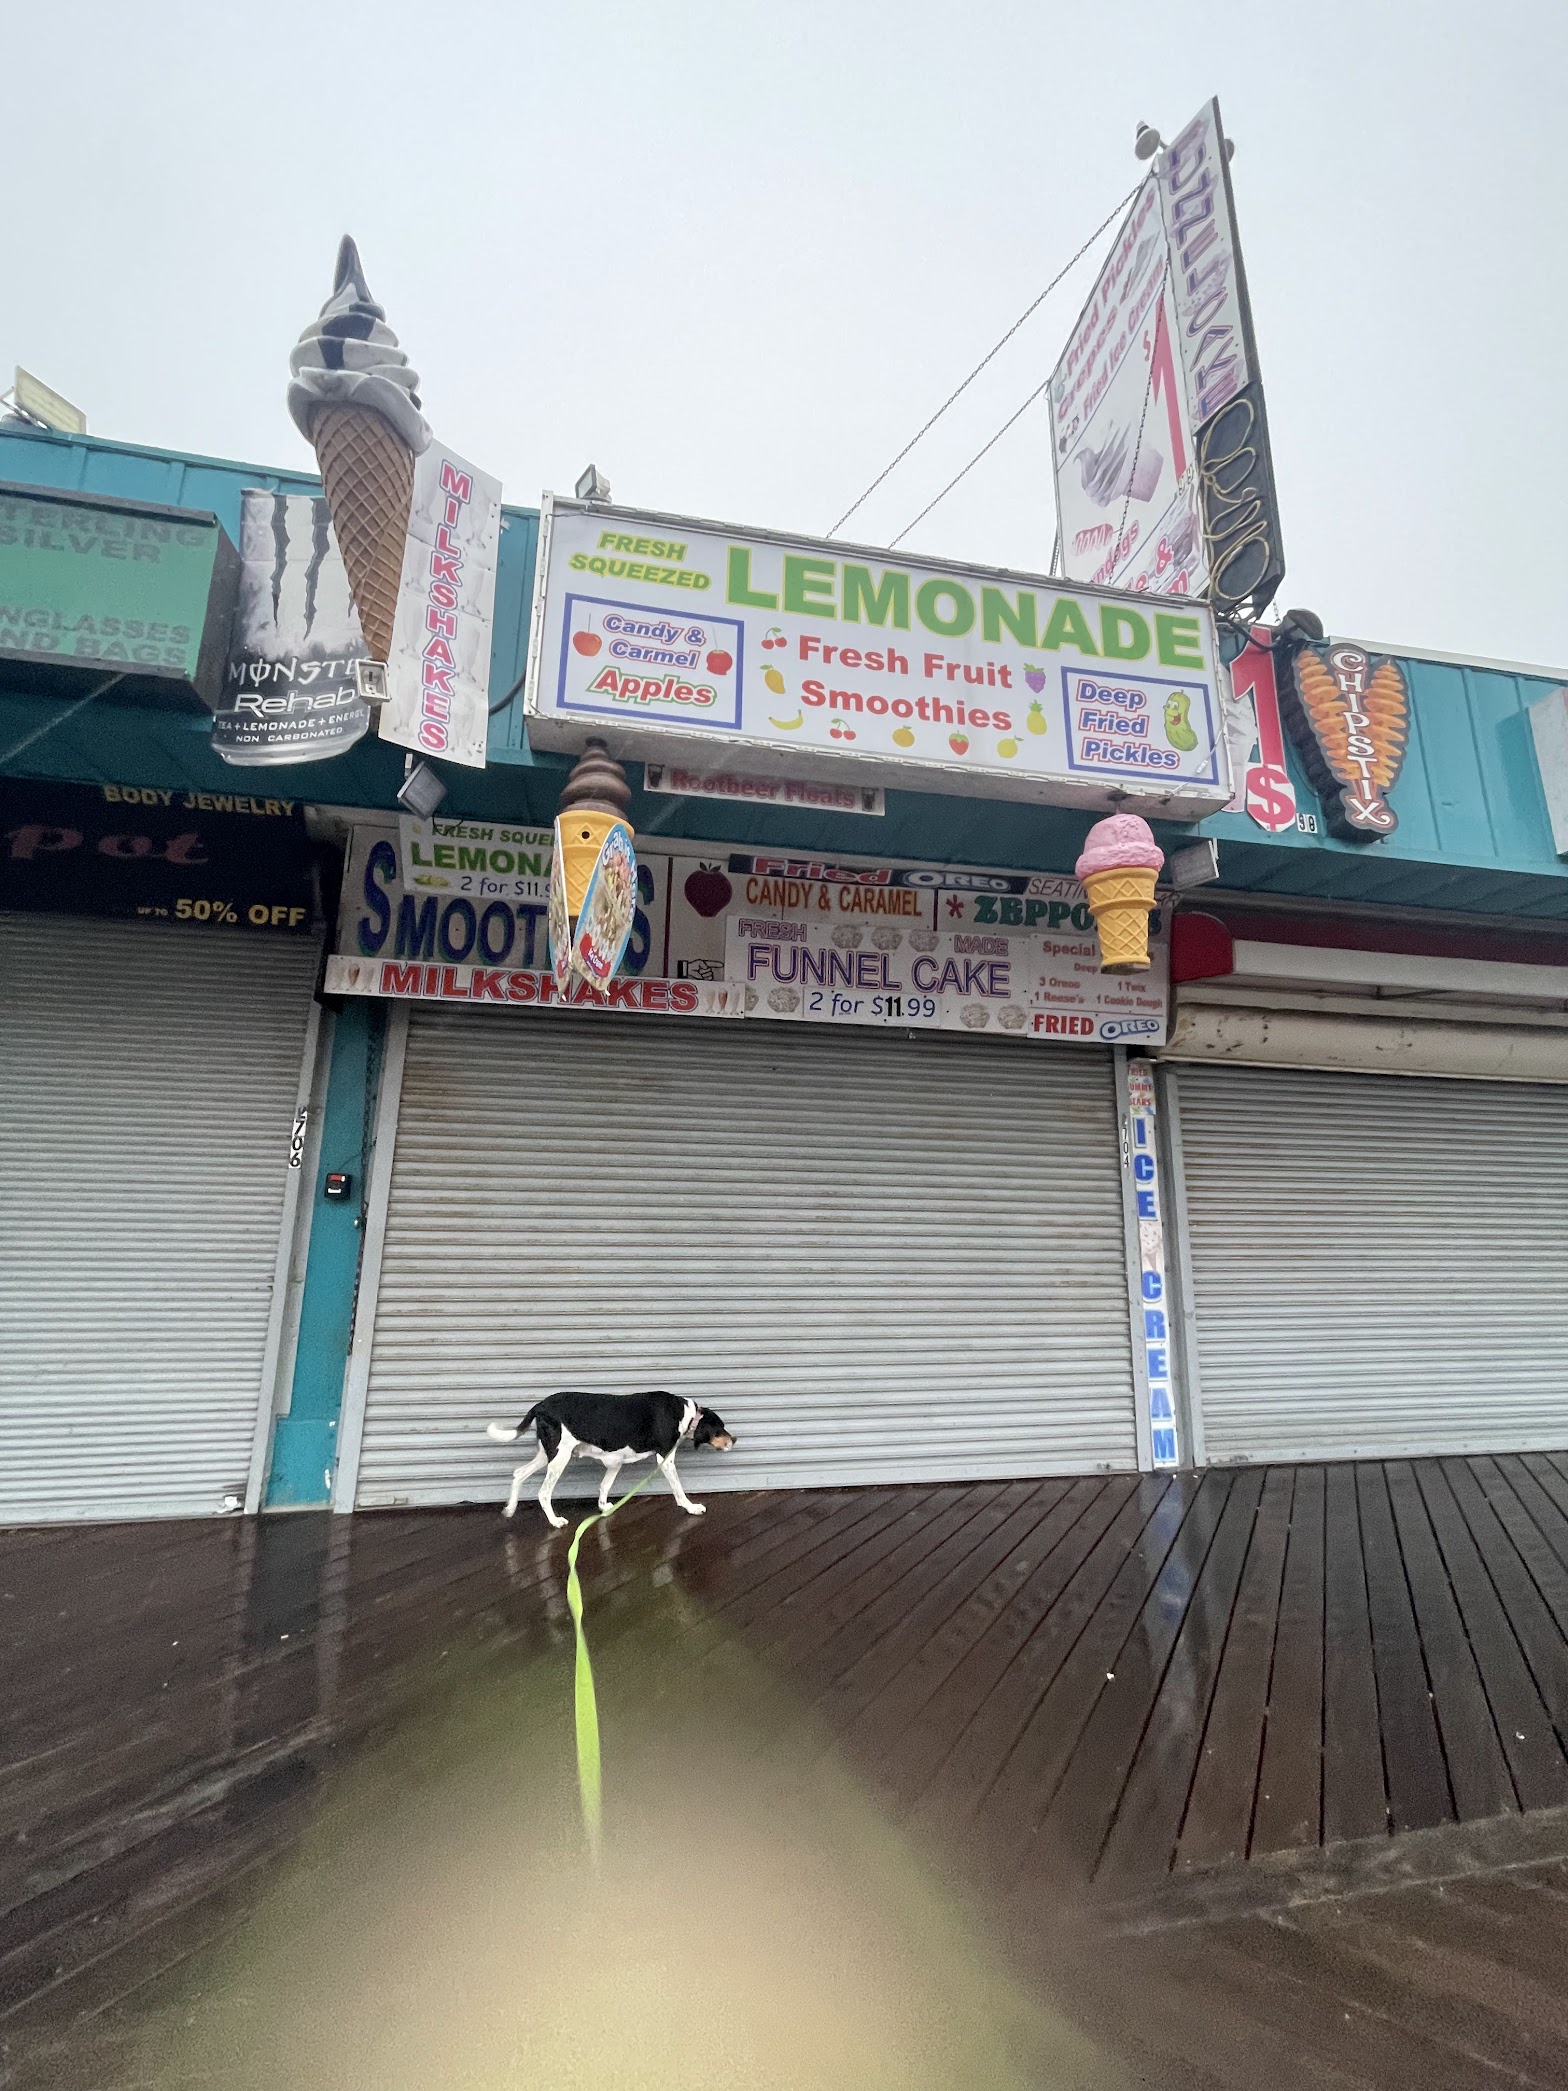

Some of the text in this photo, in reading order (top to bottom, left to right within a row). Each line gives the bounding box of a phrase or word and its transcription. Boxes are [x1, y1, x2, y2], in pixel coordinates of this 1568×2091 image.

[1066, 190, 1155, 376] Fried Pickles
[1057, 304, 1118, 423] Crepes
[1109, 330, 1127, 374] Ice
[0, 500, 206, 546] TERLING
[0, 524, 160, 564] SILVER
[598, 530, 687, 561] FRESH
[569, 552, 711, 591] SQUEEZED
[419, 459, 473, 752] MILKSHAKES
[726, 545, 1206, 670] LEMONADE
[0, 606, 190, 644] NGLASSES
[603, 613, 706, 647] Candy &
[609, 638, 701, 671] Carmel
[799, 635, 1012, 689] Fresh Fruit
[233, 687, 356, 718] Rehab
[586, 665, 717, 707] Apples
[1076, 679, 1147, 712] Deep
[801, 679, 1013, 731] Smoothies
[1078, 708, 1149, 738] Fried
[243, 718, 315, 731] LEMONADE
[267, 727, 342, 742] CARBONATED
[1331, 650, 1391, 826] CHIPSTIX
[1081, 737, 1180, 769] Pickles
[104, 784, 294, 817] BODY JEWELRY
[432, 824, 554, 847] FRESH SQUE
[411, 841, 552, 877] LEMON
[752, 857, 1010, 893] Fried OREO
[460, 876, 550, 897] 2 for $11.
[746, 878, 922, 917] CANDY & CARAMEL
[175, 898, 238, 923] 50%
[248, 904, 306, 926] OFF
[738, 918, 1009, 956] FRESH MADE
[1043, 941, 1095, 956] Special
[380, 962, 698, 1012] MILKSHAKES
[748, 943, 1011, 998] FUNNEL CAKE
[809, 991, 935, 1018] 2 for $11.99
[1034, 1014, 1160, 1039] FRIED OREO
[1128, 1083, 1152, 1091] UMMY
[1134, 1117, 1158, 1220] ICE
[1142, 1271, 1177, 1464] CREAM
